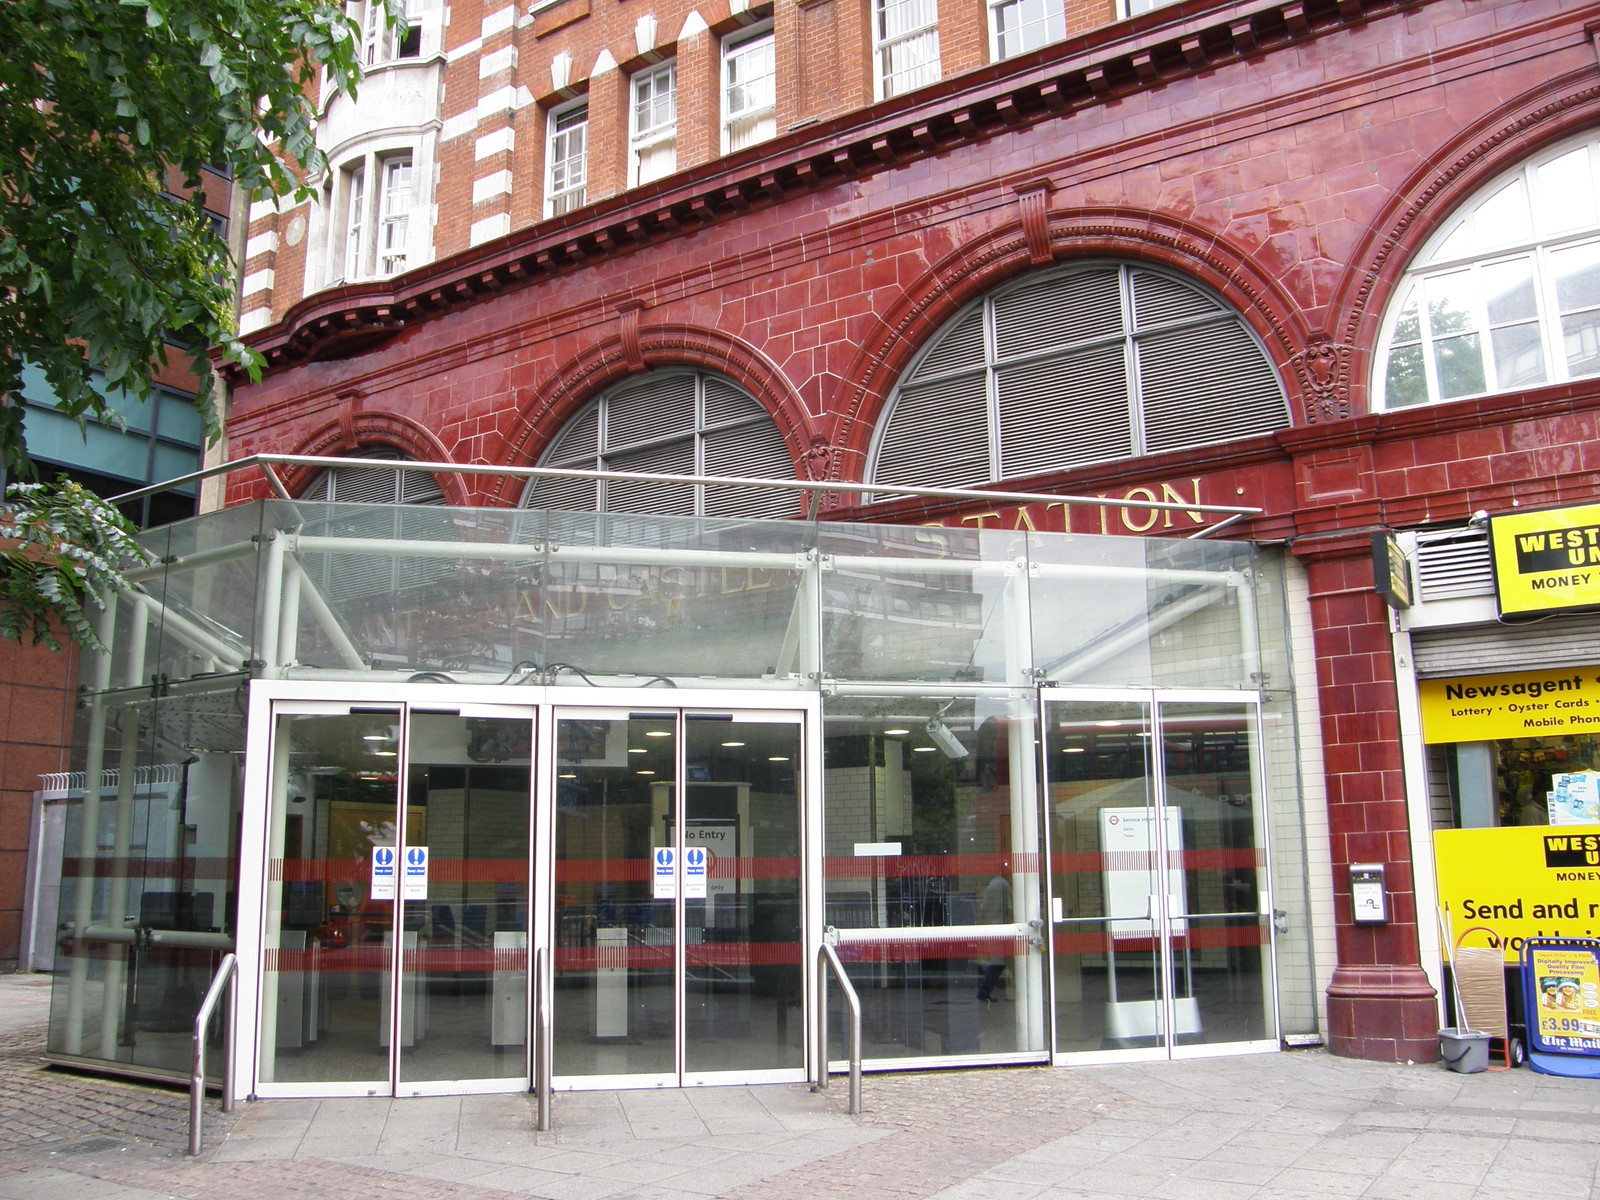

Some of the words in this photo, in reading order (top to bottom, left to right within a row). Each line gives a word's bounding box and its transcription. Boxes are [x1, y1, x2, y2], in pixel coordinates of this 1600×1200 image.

[913, 478, 1205, 561] STATION
[1531, 573, 1591, 590] MONEY
[1446, 675, 1583, 700] Newsagent
[1451, 707, 1493, 717] Lottery
[1508, 702, 1550, 714] Oyster
[1554, 698, 1590, 709] Cards
[1523, 716, 1565, 728] Mobile
[699, 830, 726, 841] Entry
[1463, 898, 1524, 920] Send
[1532, 897, 1579, 919] and
[1542, 1017, 1580, 1032] £3.99
[1541, 1035, 1567, 1047] The
[1568, 1037, 1600, 1050] Mail
